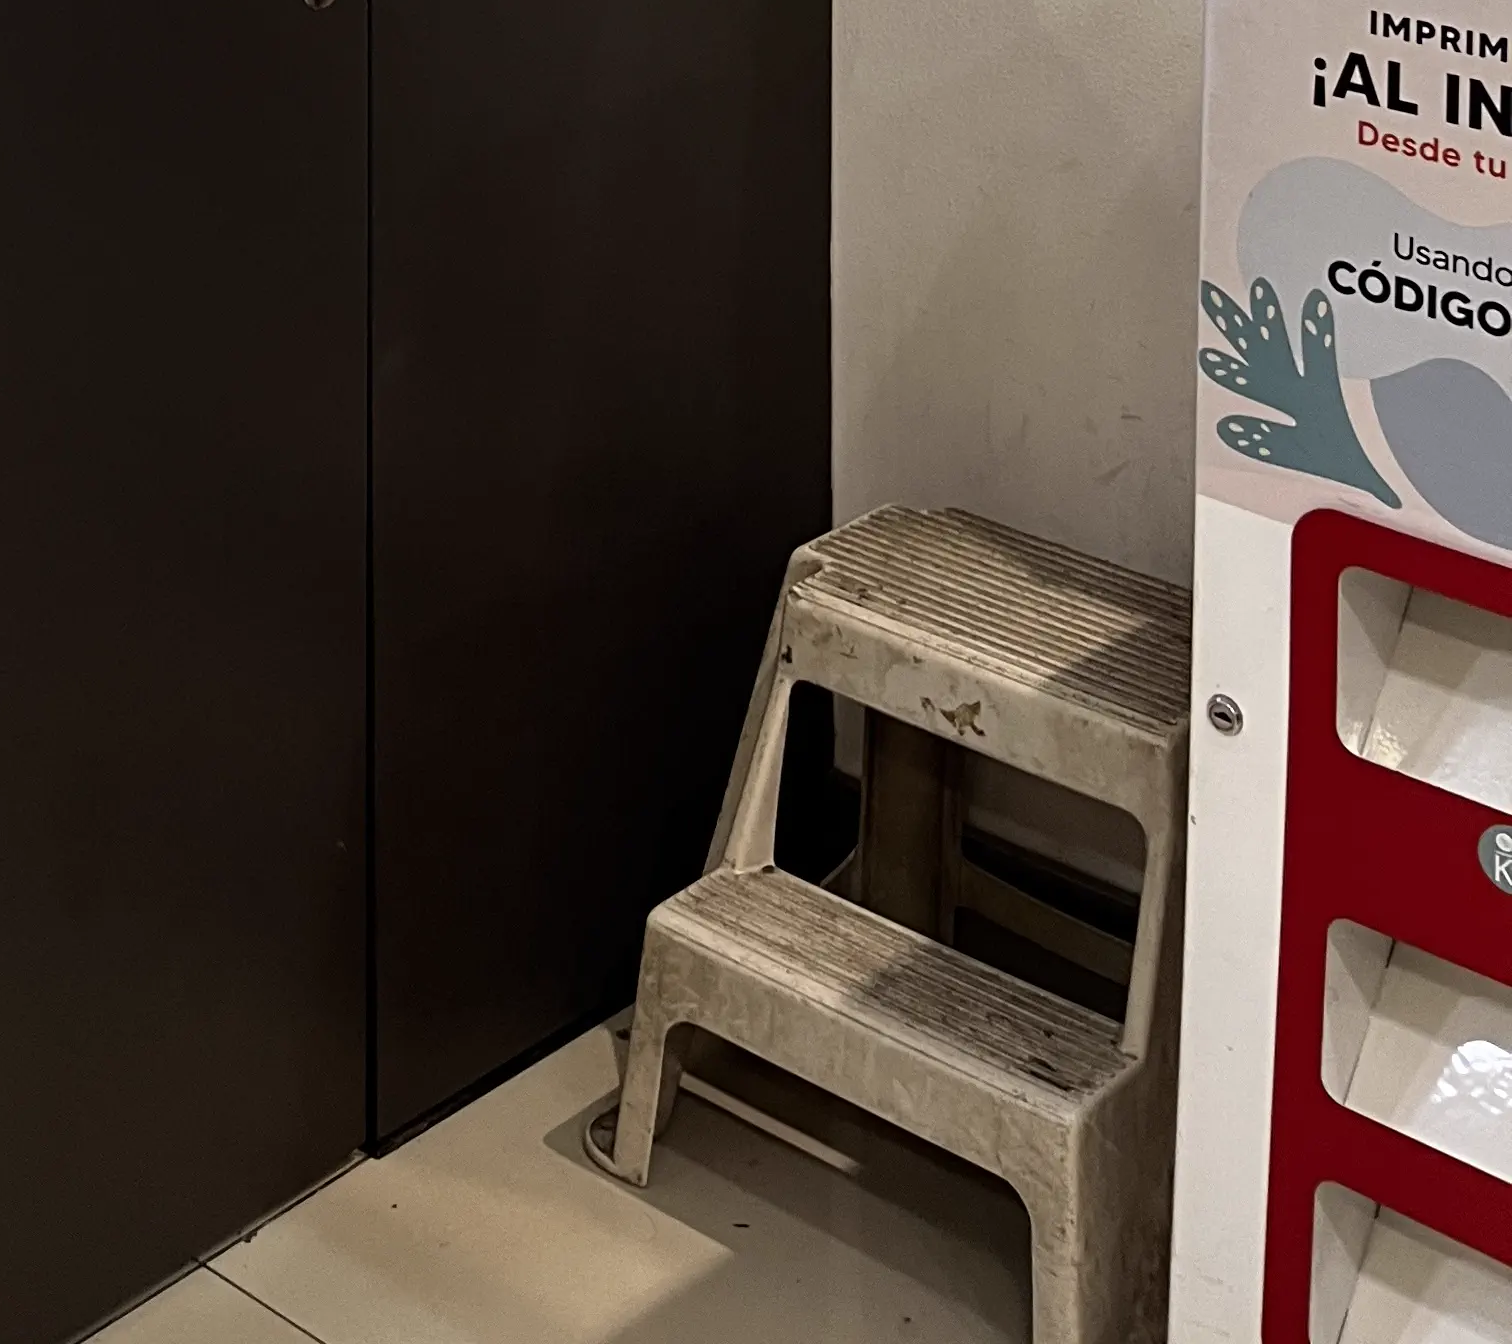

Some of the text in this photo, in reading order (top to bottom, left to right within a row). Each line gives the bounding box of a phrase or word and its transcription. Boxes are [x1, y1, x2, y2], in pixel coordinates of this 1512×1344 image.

[1357, 120, 1506, 180] Desde tu
[1394, 232, 1512, 287] Usando
[1327, 260, 1512, 338] CÓDIGO
